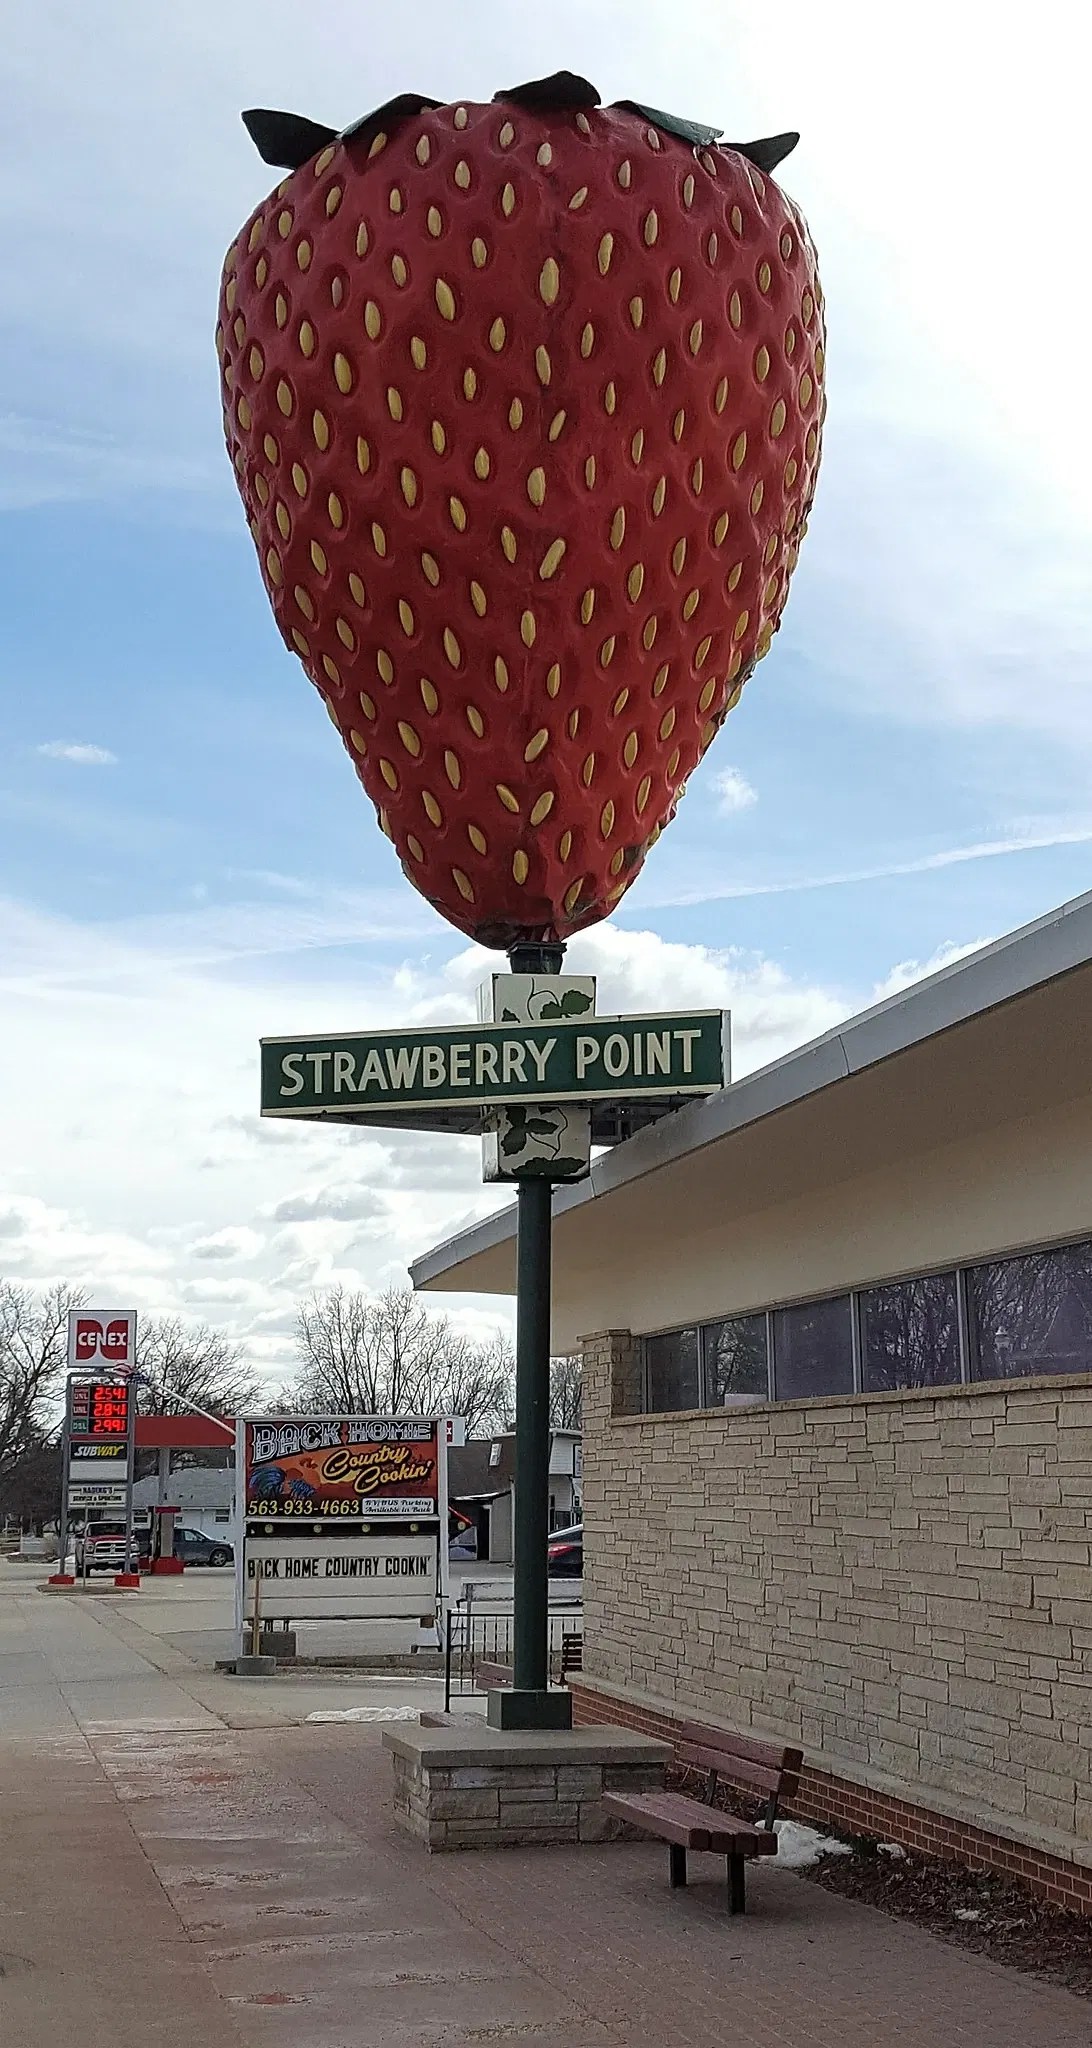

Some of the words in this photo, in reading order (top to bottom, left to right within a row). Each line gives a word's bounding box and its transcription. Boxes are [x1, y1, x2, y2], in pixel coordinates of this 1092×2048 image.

[279, 1038, 557, 1096] STRAWBERRY
[576, 1029, 703, 1080] POINT
[78, 1332, 127, 1346] CENEX
[74, 1445, 124, 1457] SUBWAY
[252, 1422, 341, 1464] BACK
[348, 1421, 432, 1442] HOME
[323, 1445, 409, 1477] Country
[353, 1460, 432, 1494] Cookin'
[248, 1500, 360, 1515] 563-933-4663
[285, 1559, 319, 1577] HOME
[325, 1557, 379, 1576] COUNTRY
[385, 1556, 431, 1576] COOKIN'
